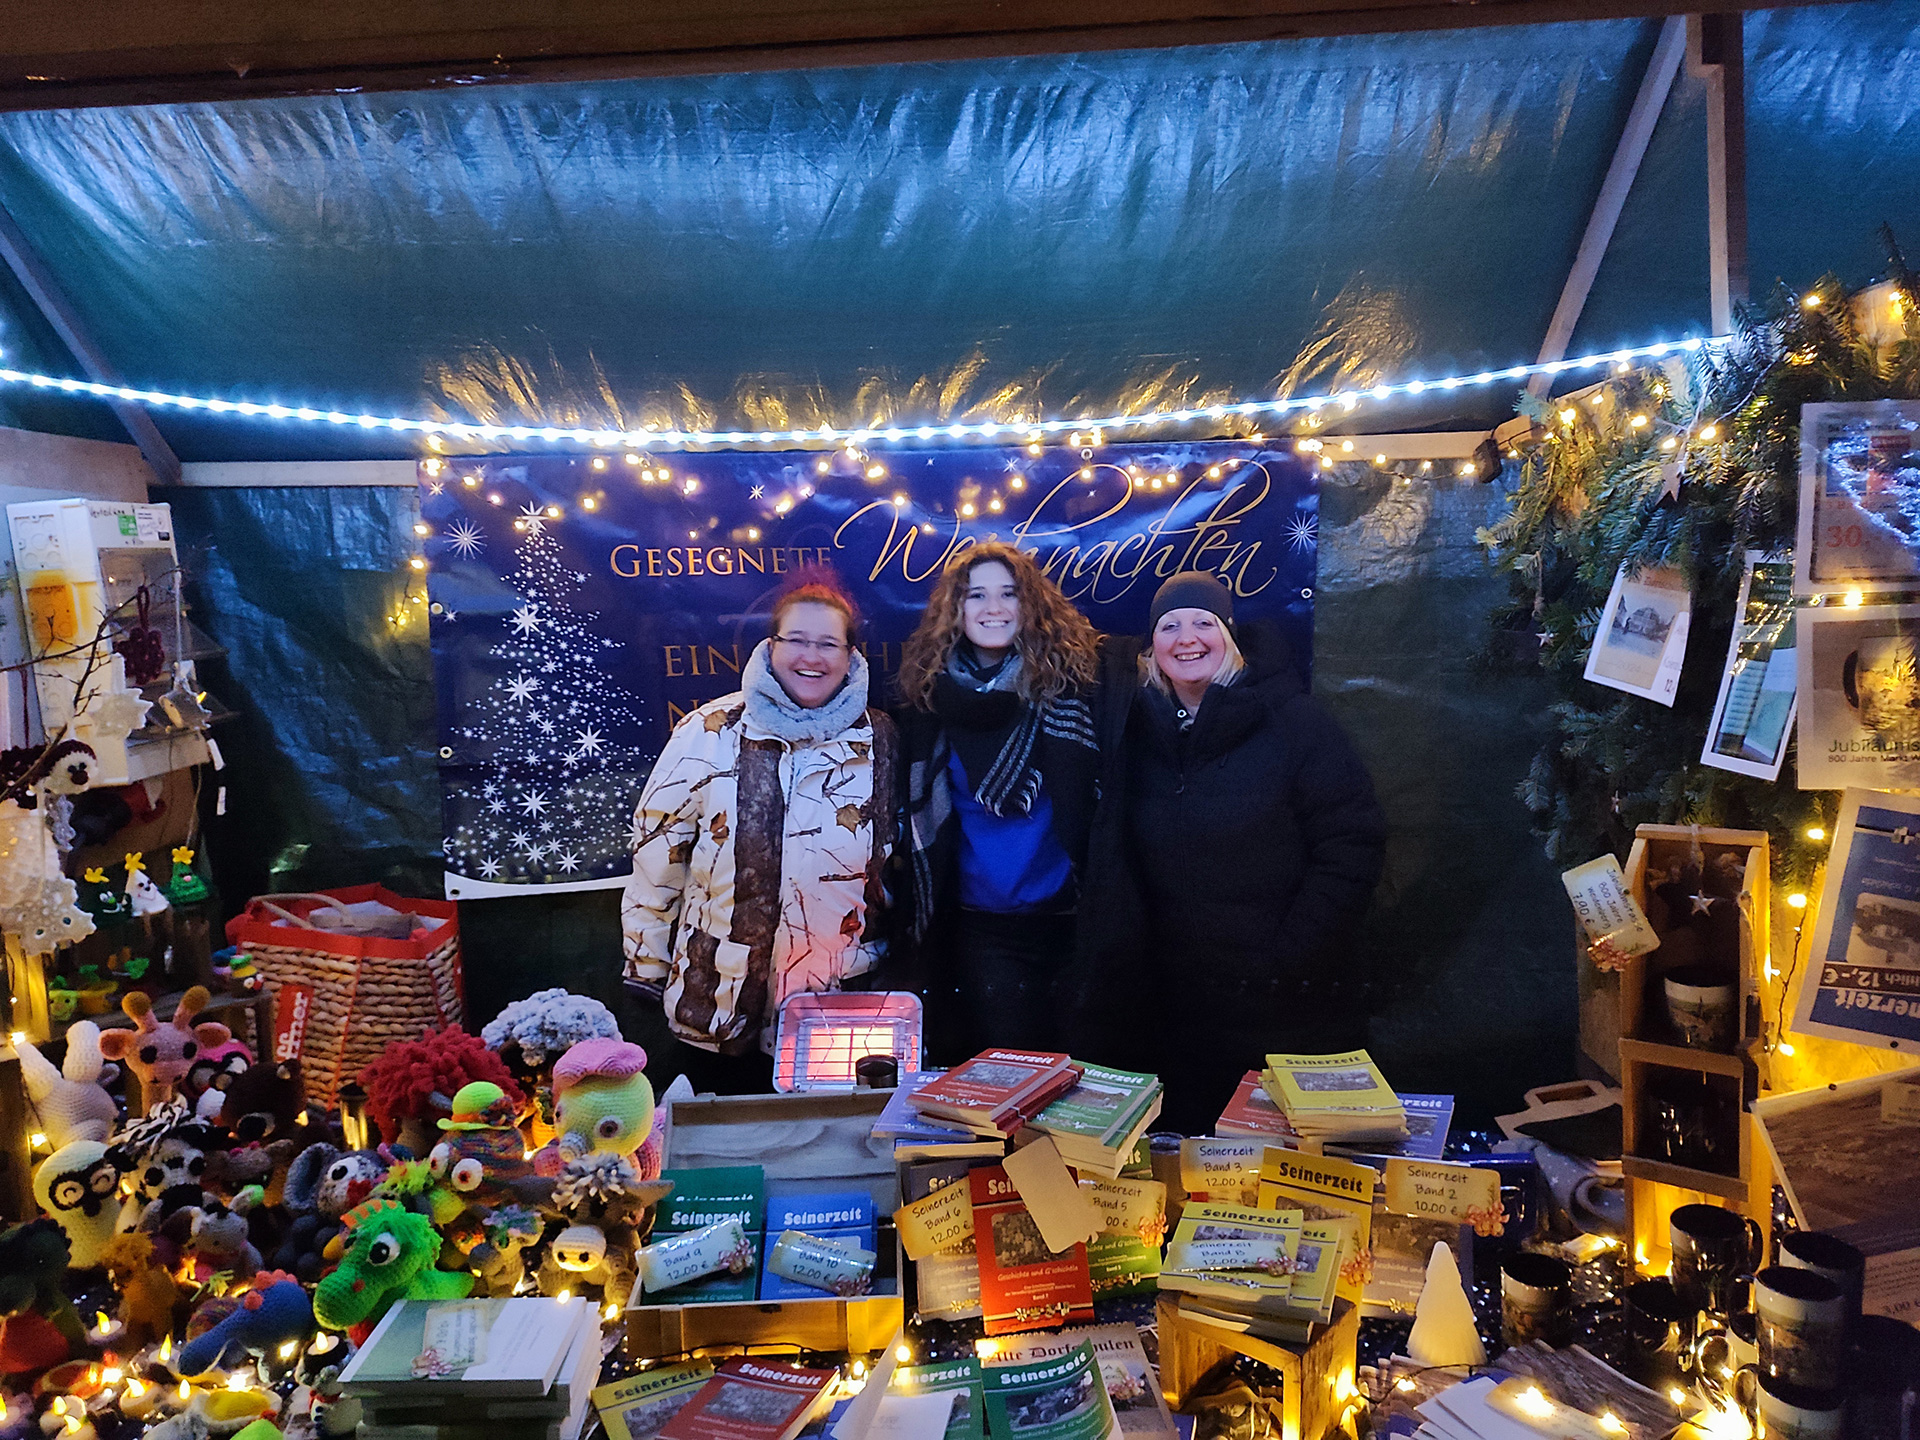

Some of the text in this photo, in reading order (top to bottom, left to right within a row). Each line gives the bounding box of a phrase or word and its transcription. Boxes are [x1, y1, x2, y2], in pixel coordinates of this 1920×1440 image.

[610, 458, 1278, 604] GESEGNETE Wehnachten
[988, 1051, 1054, 1065] Seinerzeit
[1285, 1056, 1362, 1066] Seinerzeit
[1084, 1067, 1144, 1084] inerzeit
[1199, 1145, 1254, 1157] Seinerzeit
[1204, 1162, 1242, 1173] Band 3
[1407, 1165, 1468, 1183] Seinerzeit
[1239, 1178, 1246, 1186] €
[1279, 1161, 1363, 1194] Seinerzeit
[1415, 1184, 1457, 1199] Band 2
[911, 1187, 965, 1219] Seinerzeit
[1092, 1197, 1128, 1211] Band 5
[1450, 1206, 1457, 1216] €
[671, 1210, 751, 1226] Seinerzeit
[783, 1207, 862, 1226] Seinerzeit
[924, 1206, 961, 1230] Band 6
[1122, 1218, 1129, 1228] €
[1201, 1208, 1290, 1225] Seinerzeit
[963, 1220, 971, 1230] €
[664, 1252, 691, 1268] Band
[702, 1260, 709, 1269] €
[826, 1257, 839, 1269] 10
[1028, 1340, 1135, 1358] Dorfsulen
[738, 1362, 823, 1386] Seinerzeit
[1000, 1352, 1088, 1385] Seinerzeit
[613, 1368, 703, 1400] Seinerzeit
